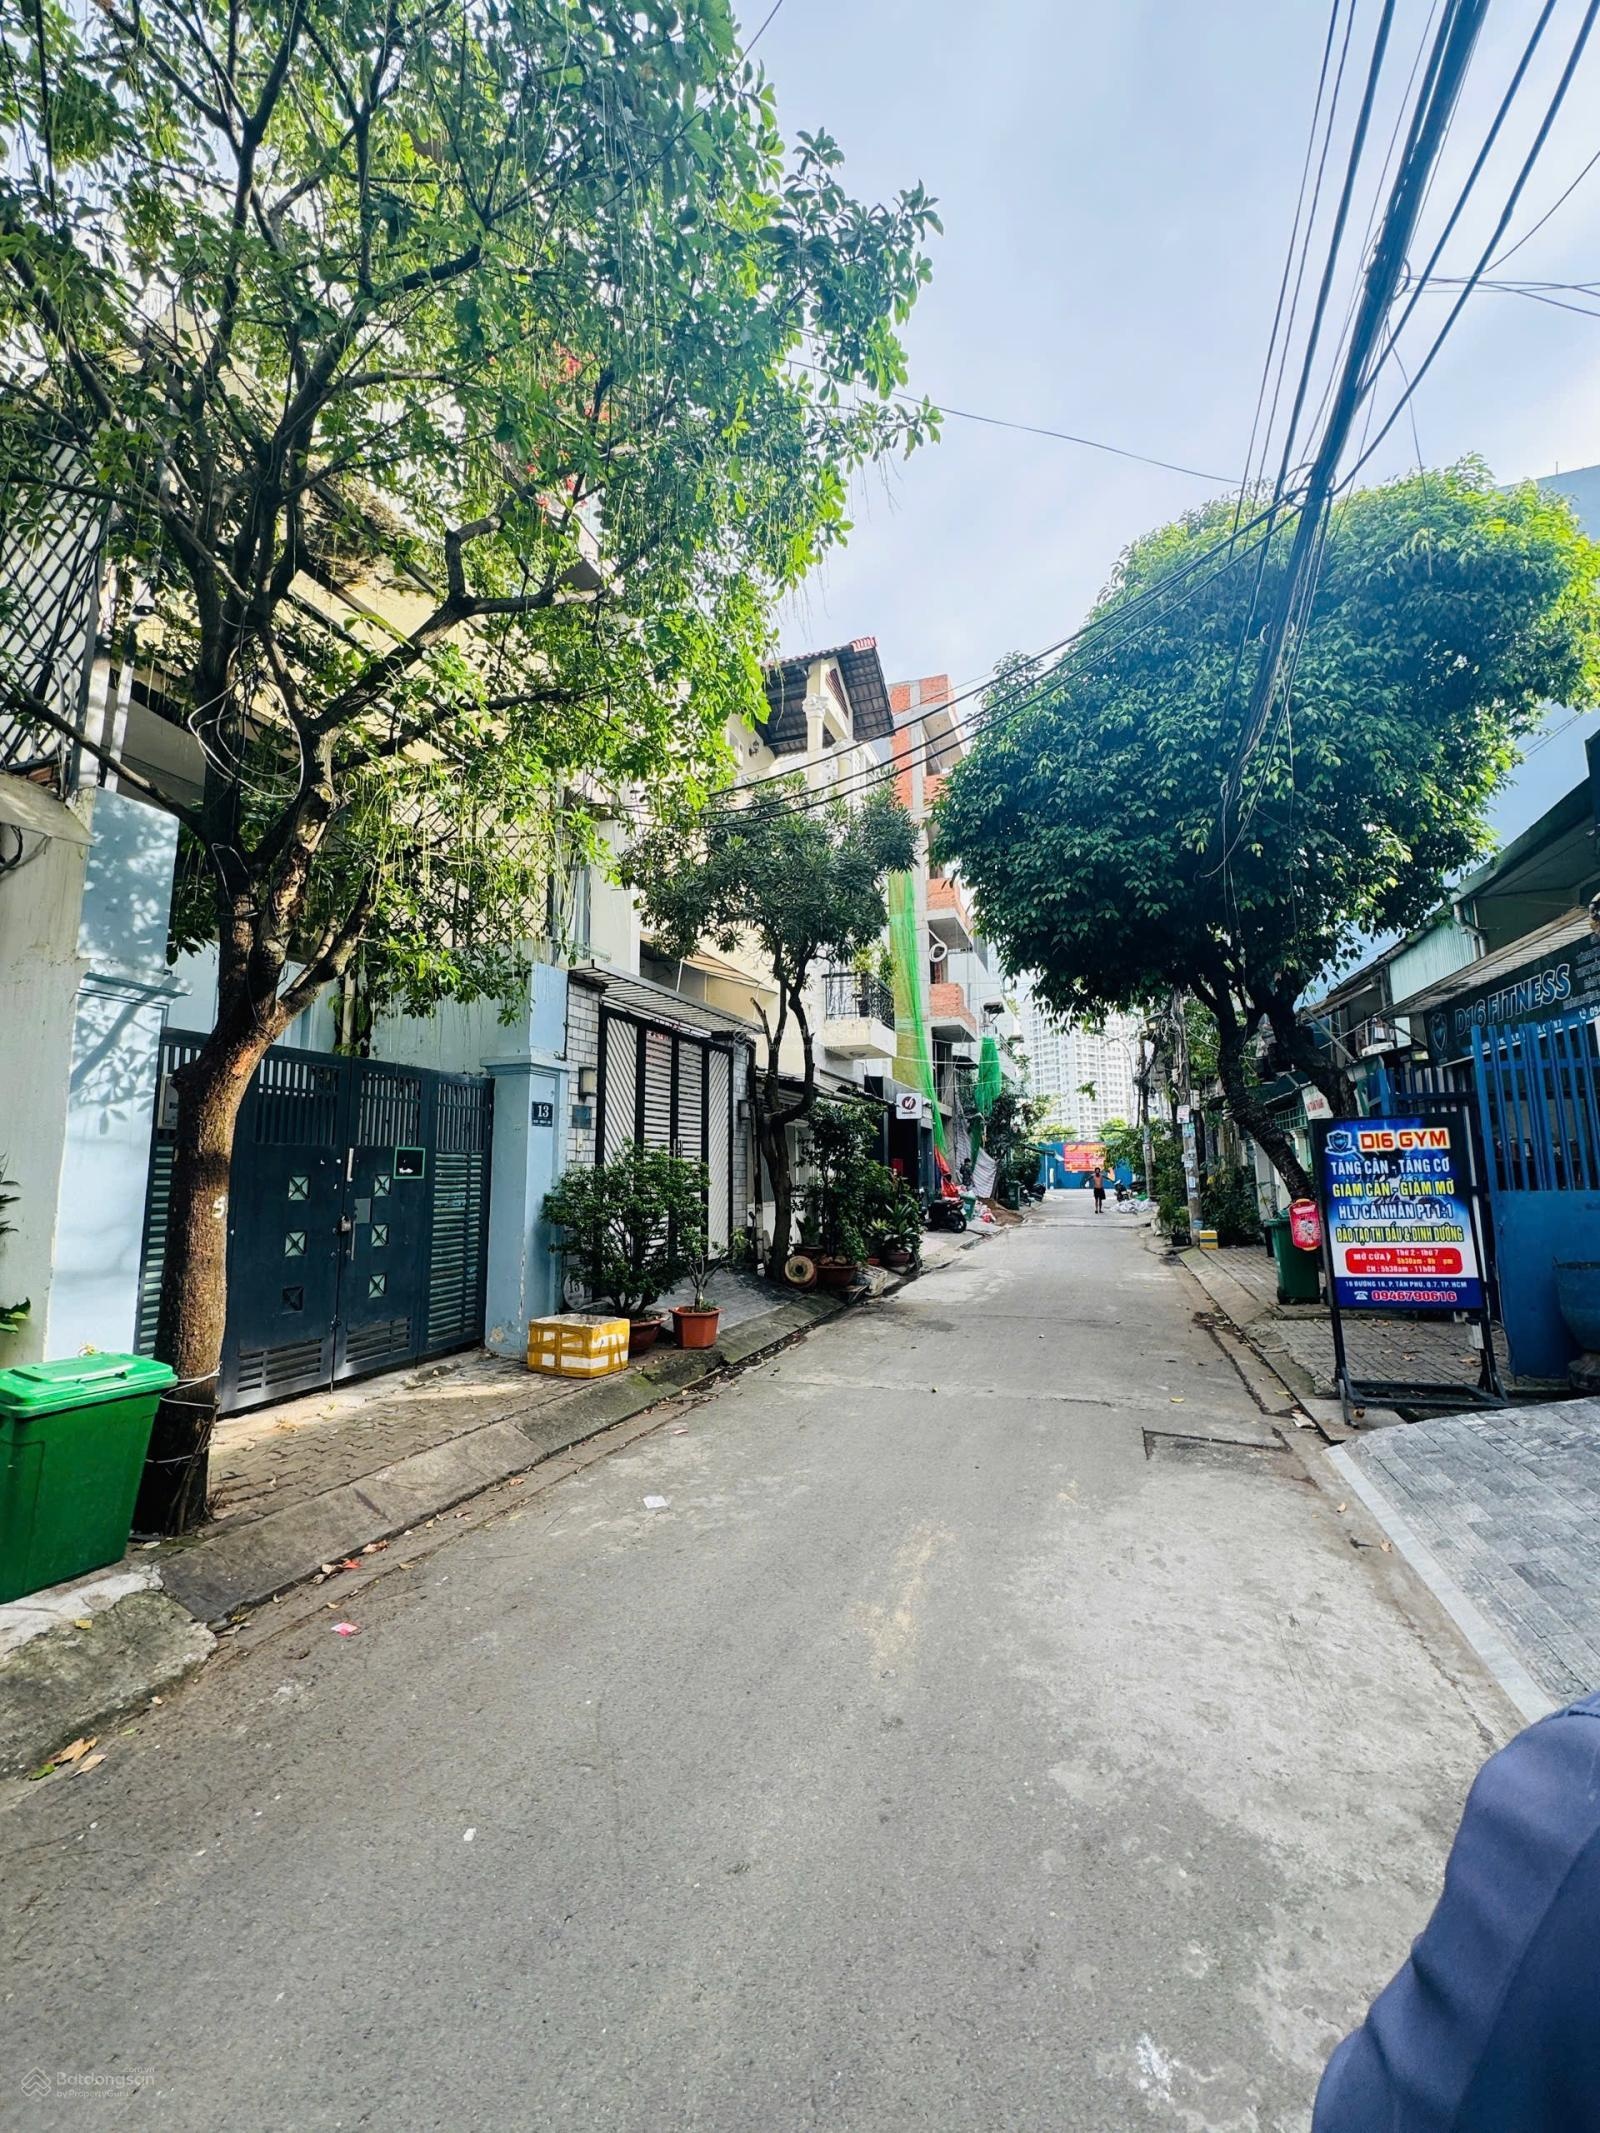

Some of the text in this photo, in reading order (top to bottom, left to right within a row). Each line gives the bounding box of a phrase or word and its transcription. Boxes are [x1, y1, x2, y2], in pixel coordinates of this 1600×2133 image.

[1488, 963, 1571, 1025] FITNESS
[538, 1105, 550, 1118] 13
[1398, 1129, 1449, 1149] GYM
[1331, 1159, 1362, 1176] TĂNG
[1364, 1157, 1389, 1175] CÂN
[1398, 1157, 1431, 1174] TĂNG
[1433, 1156, 1450, 1173] CƠ
[1400, 1176, 1433, 1196] GIẢM
[1339, 1204, 1359, 1219] HLV
[1380, 1202, 1414, 1219] NHÂN
[1416, 1203, 1431, 1219] PT
[1434, 1203, 1454, 1218] 1:1
[1354, 1226, 1371, 1246] TẠO
[1370, 1226, 1384, 1242] THI
[1403, 1227, 1411, 1242] &
[1415, 1265, 1436, 1273] 11h00
[1371, 1290, 1458, 1302] 0946790616
